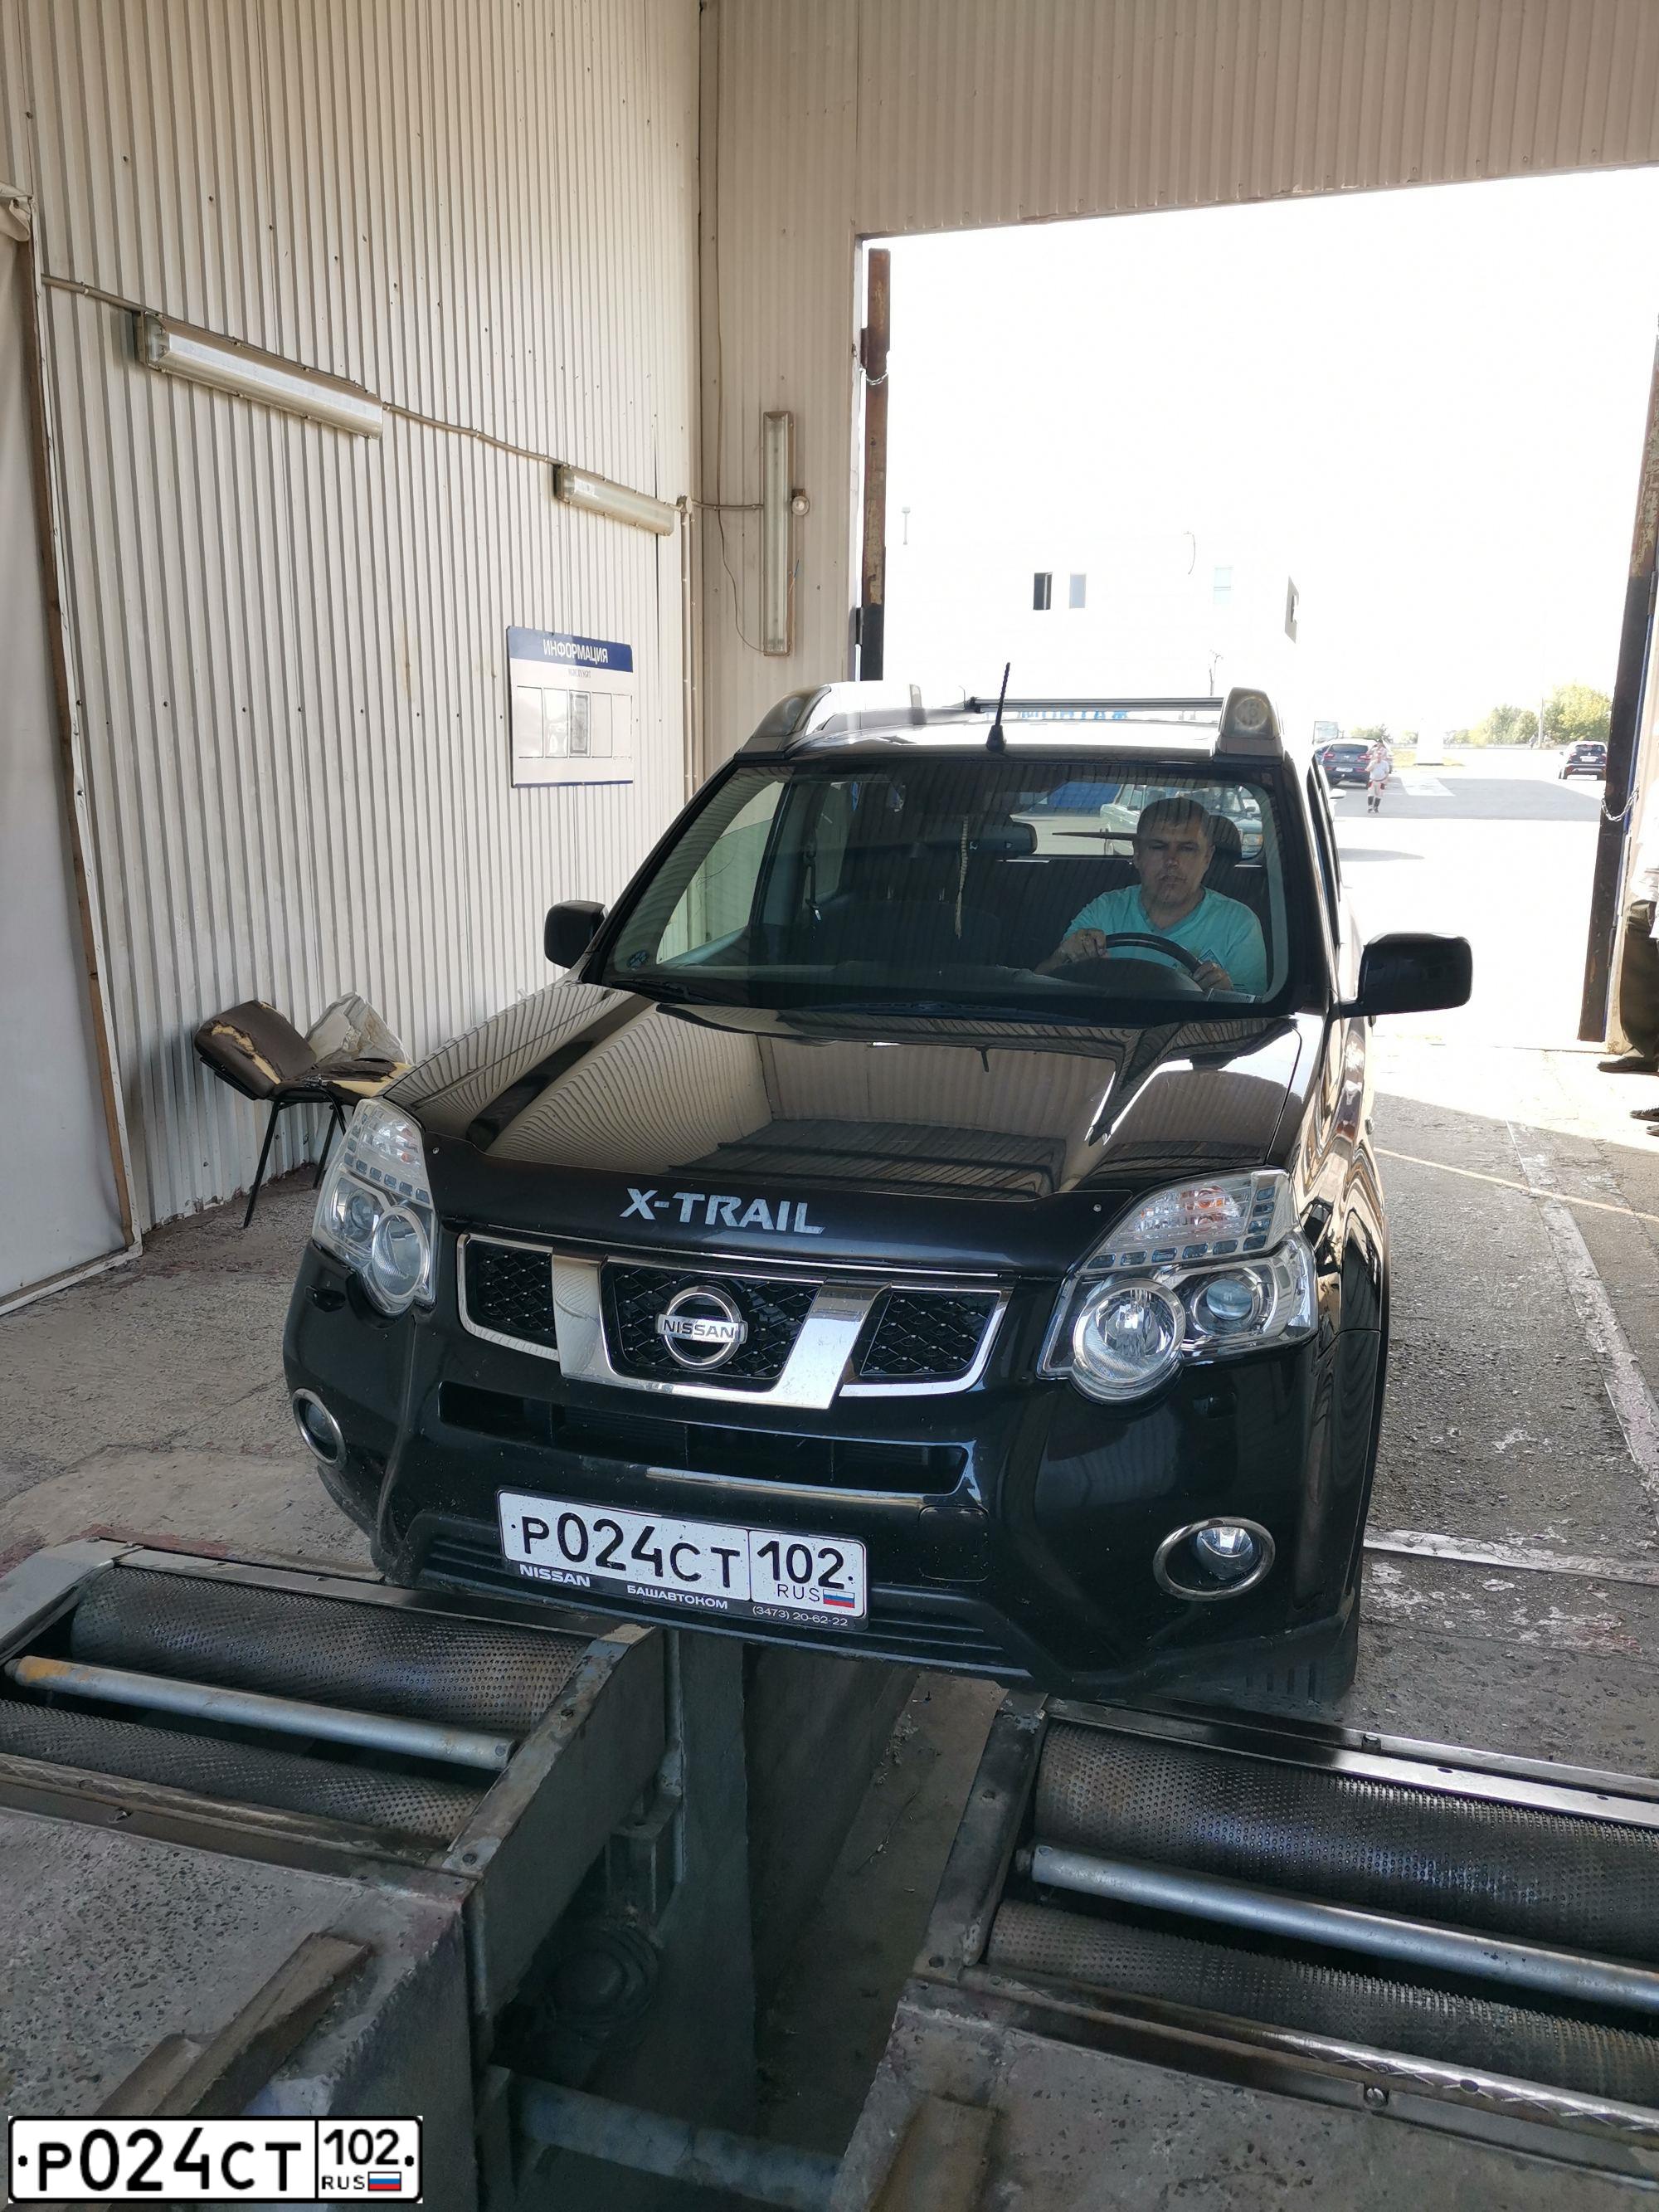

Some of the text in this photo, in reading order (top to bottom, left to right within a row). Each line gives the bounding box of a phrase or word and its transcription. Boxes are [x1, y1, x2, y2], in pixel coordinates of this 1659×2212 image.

[542, 639, 609, 665] ИНФОРМАЦИЯ
[619, 1188, 826, 1235] X-TRAIL
[663, 1319, 735, 1339] NISSAN
[521, 1512, 845, 1590] Р024СТ 102
[519, 1564, 591, 1588] NISSAN
[626, 1584, 728, 1610] БАШАВТОКОМ
[776, 1583, 821, 1602] RUS
[752, 1605, 848, 1627] (3473) 20-62-22
